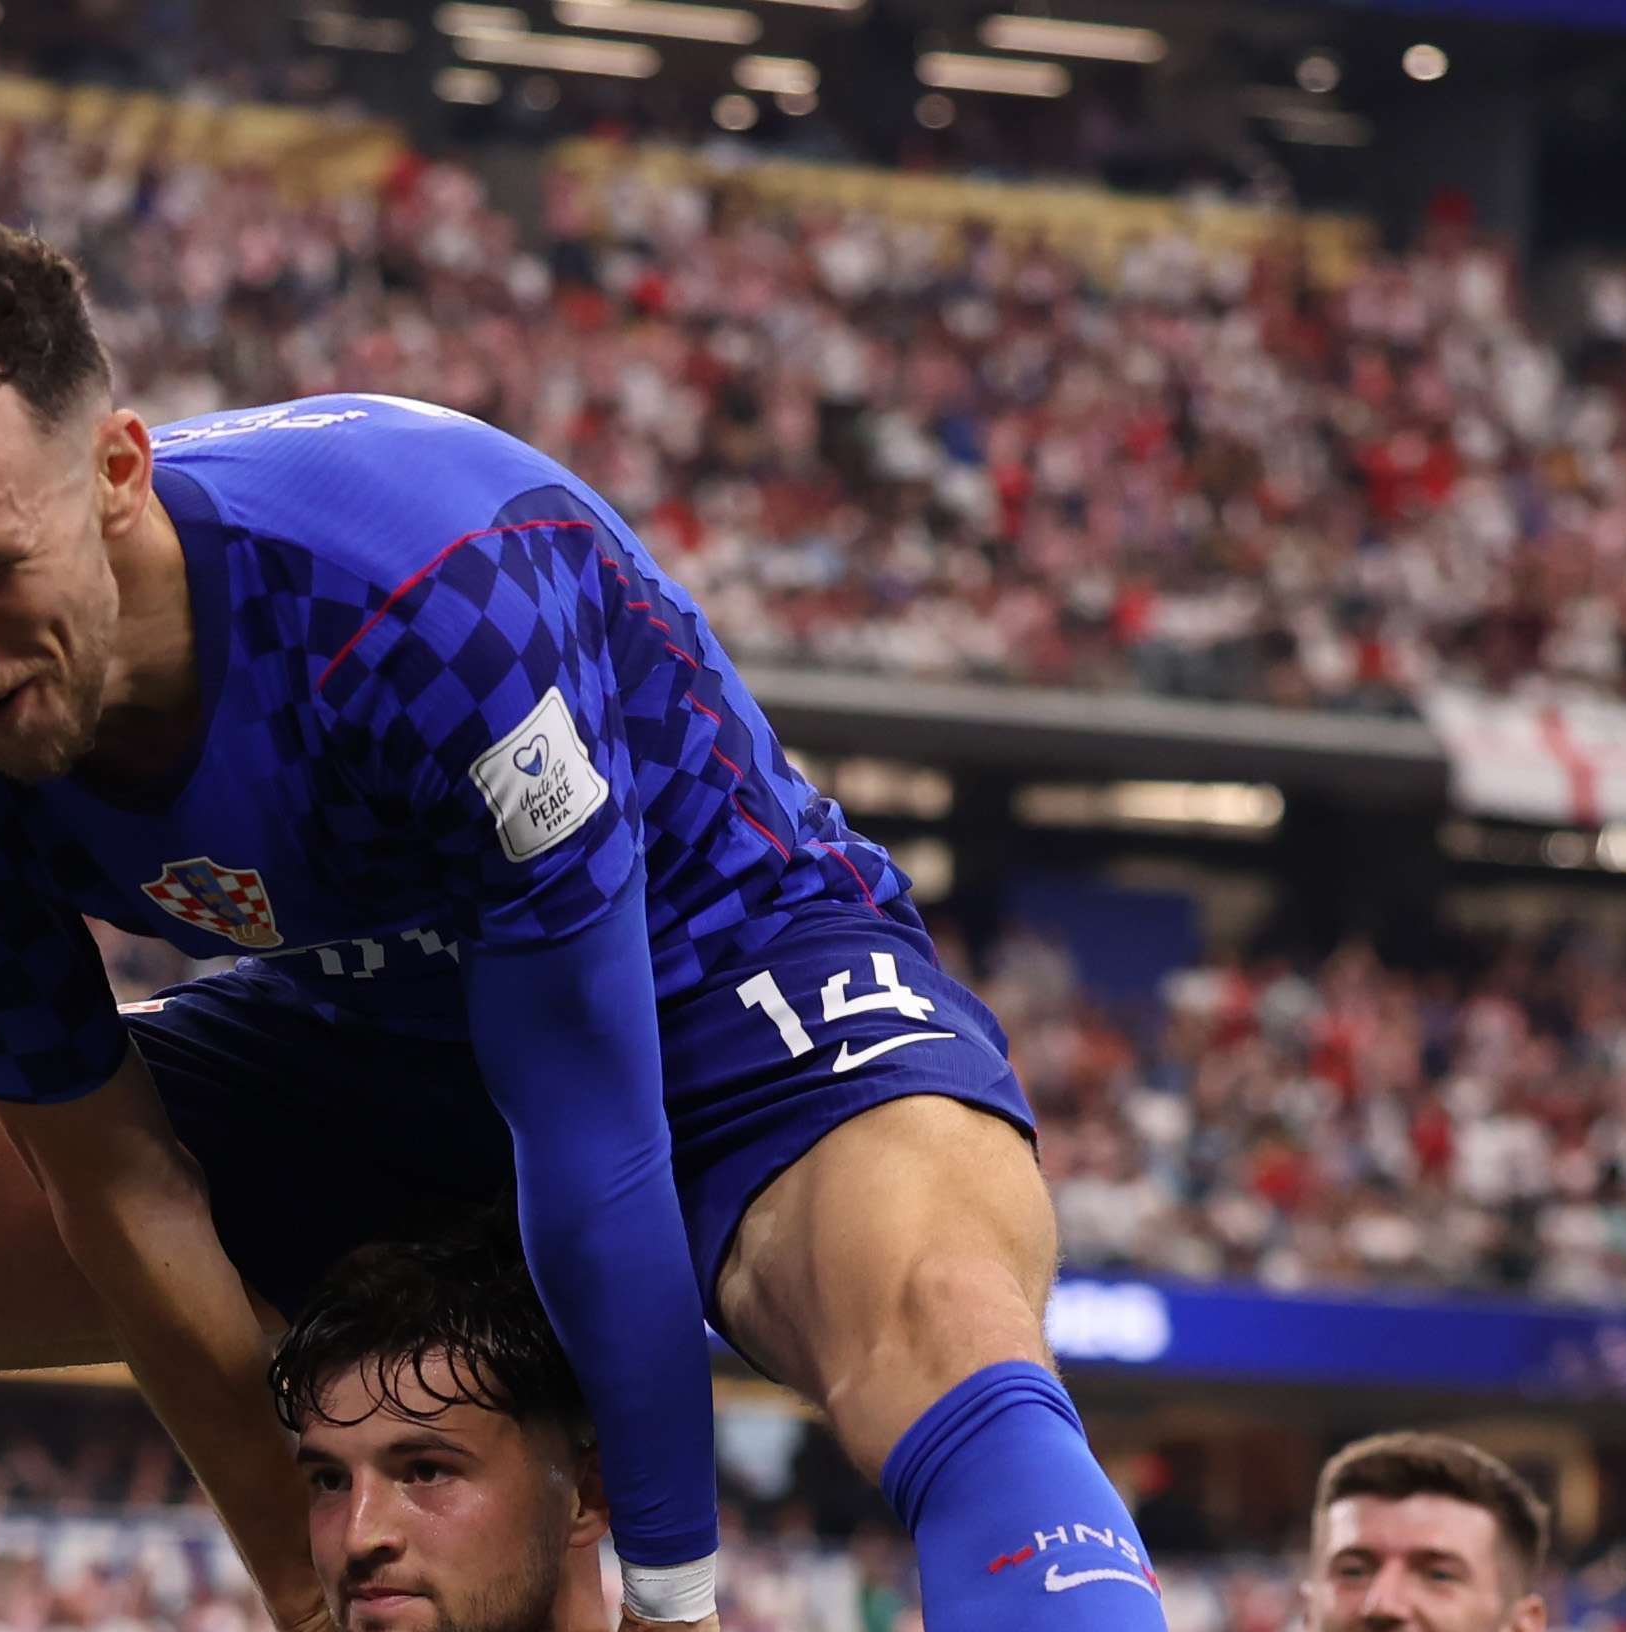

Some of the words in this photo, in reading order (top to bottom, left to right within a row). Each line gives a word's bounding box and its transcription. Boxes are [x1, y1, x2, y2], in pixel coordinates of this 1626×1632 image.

[529, 776, 574, 828] PEACE
[546, 809, 571, 832] FIFA
[736, 952, 935, 1058] 14
[1034, 1523, 1140, 1565] HNS
